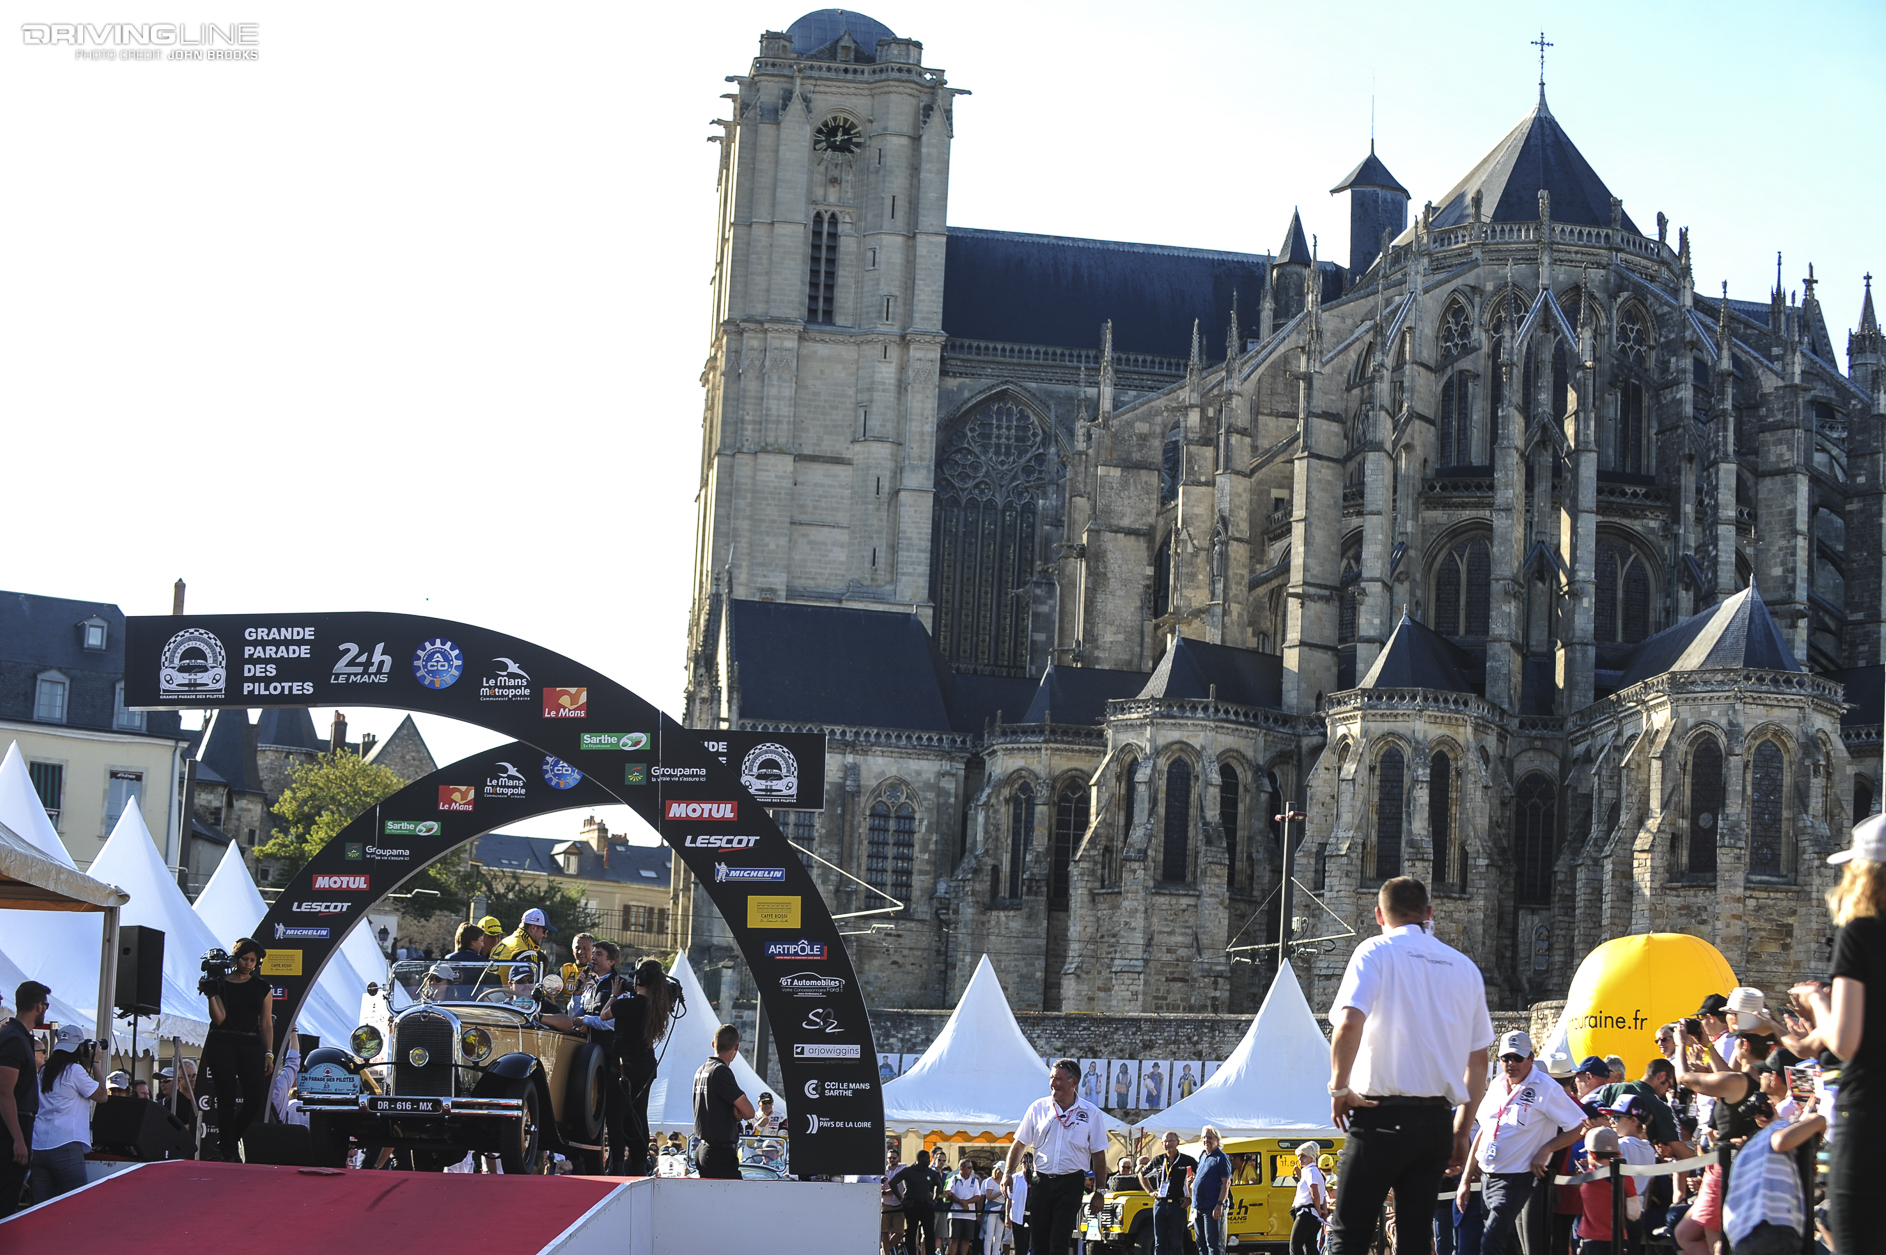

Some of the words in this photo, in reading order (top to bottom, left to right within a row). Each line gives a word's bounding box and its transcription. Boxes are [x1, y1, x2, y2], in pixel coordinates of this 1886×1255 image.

[244, 627, 315, 640] GRANDE
[244, 645, 311, 658] PARADE
[332, 642, 392, 673] 24h
[243, 663, 277, 677] DES
[330, 675, 348, 683] LE
[349, 674, 389, 683] MANS
[483, 677, 496, 686] Le
[497, 677, 527, 686] Mans
[243, 682, 314, 695] PILOTES
[545, 708, 556, 718] Le
[559, 708, 586, 718] Mans
[583, 734, 618, 744] Sarthe
[651, 766, 707, 777] Groupama
[487, 777, 498, 786] Le
[498, 777, 524, 786] Mans
[440, 802, 449, 810] Le
[450, 802, 473, 811] Mans
[668, 803, 735, 819] MOTUL
[387, 821, 415, 830] Sarthe
[684, 836, 760, 848] LESCOT
[365, 845, 410, 857] Groupama
[729, 870, 782, 878] MICHELIN
[314, 876, 367, 888] MOTUL
[292, 902, 351, 912] LESCOT
[768, 939, 821, 955] ARTIPÔLE
[839, 1082, 848, 1090] LE
[377, 1101, 389, 1110] DR
[396, 1101, 412, 1110] 616
[419, 1102, 433, 1111] MX
